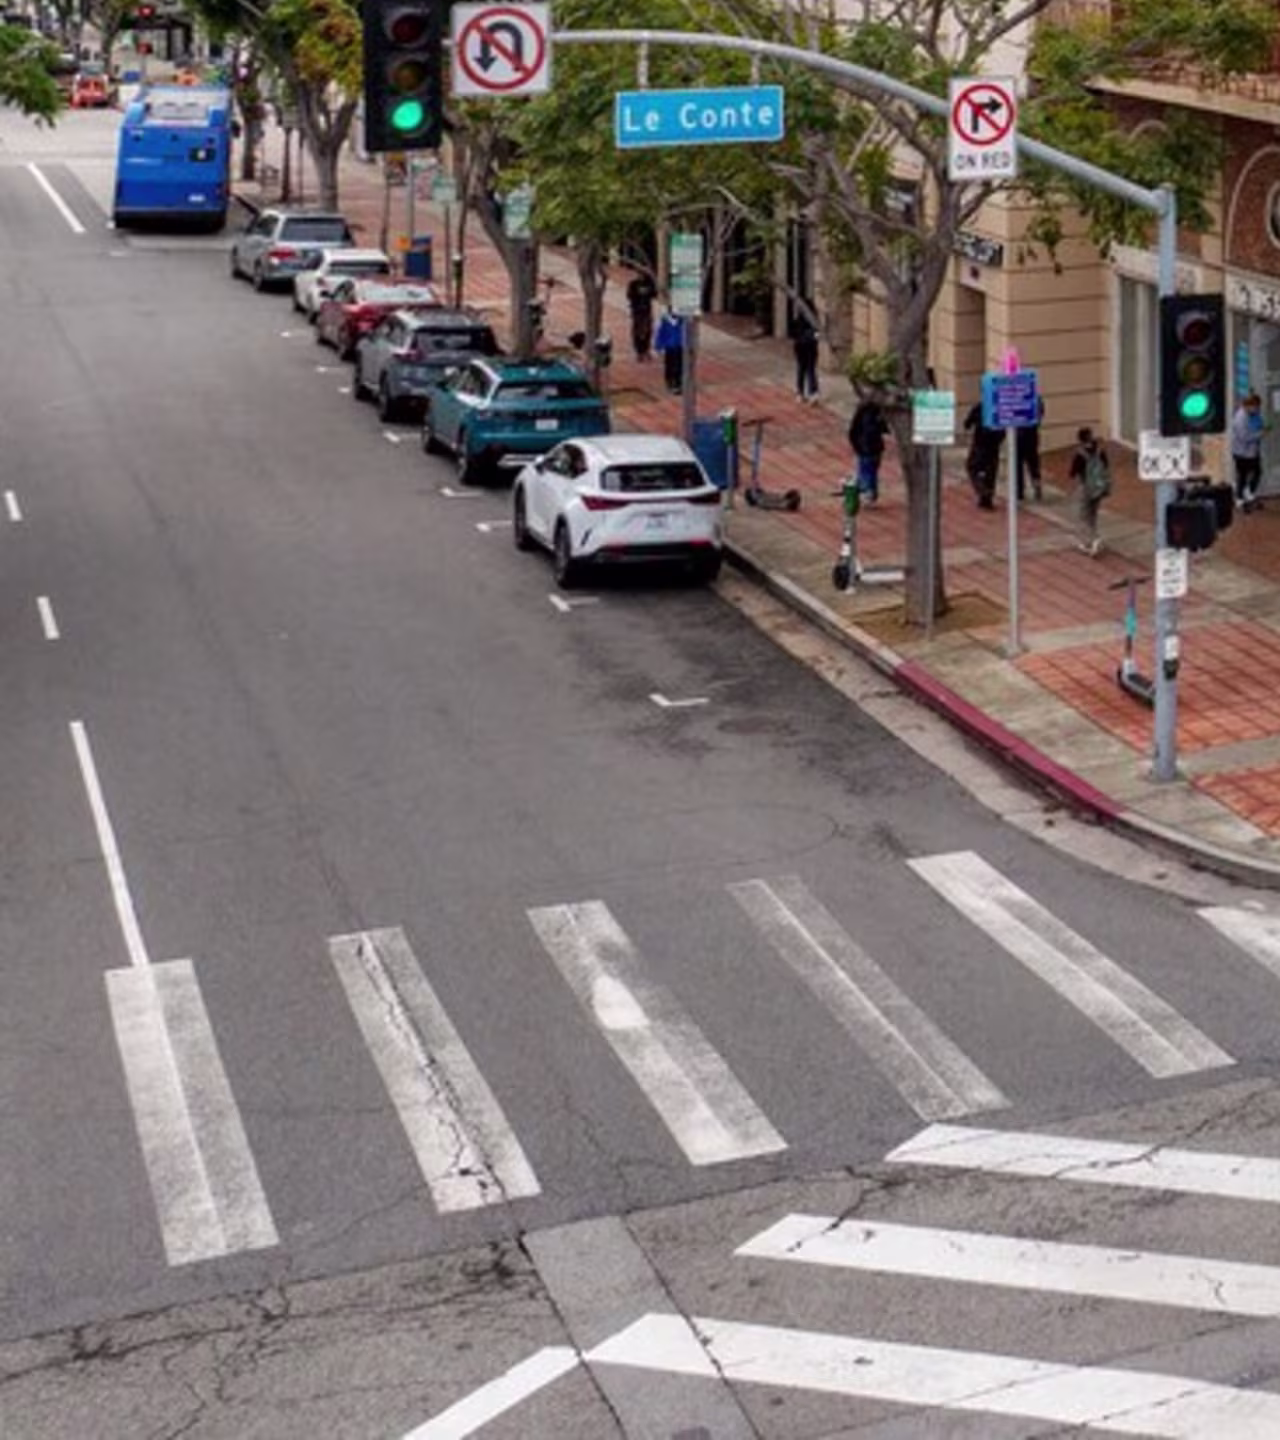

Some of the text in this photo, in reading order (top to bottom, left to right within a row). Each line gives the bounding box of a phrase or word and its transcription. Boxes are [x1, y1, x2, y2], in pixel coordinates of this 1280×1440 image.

[622, 102, 774, 132] Le Conte
[954, 151, 1010, 171] ON RED
